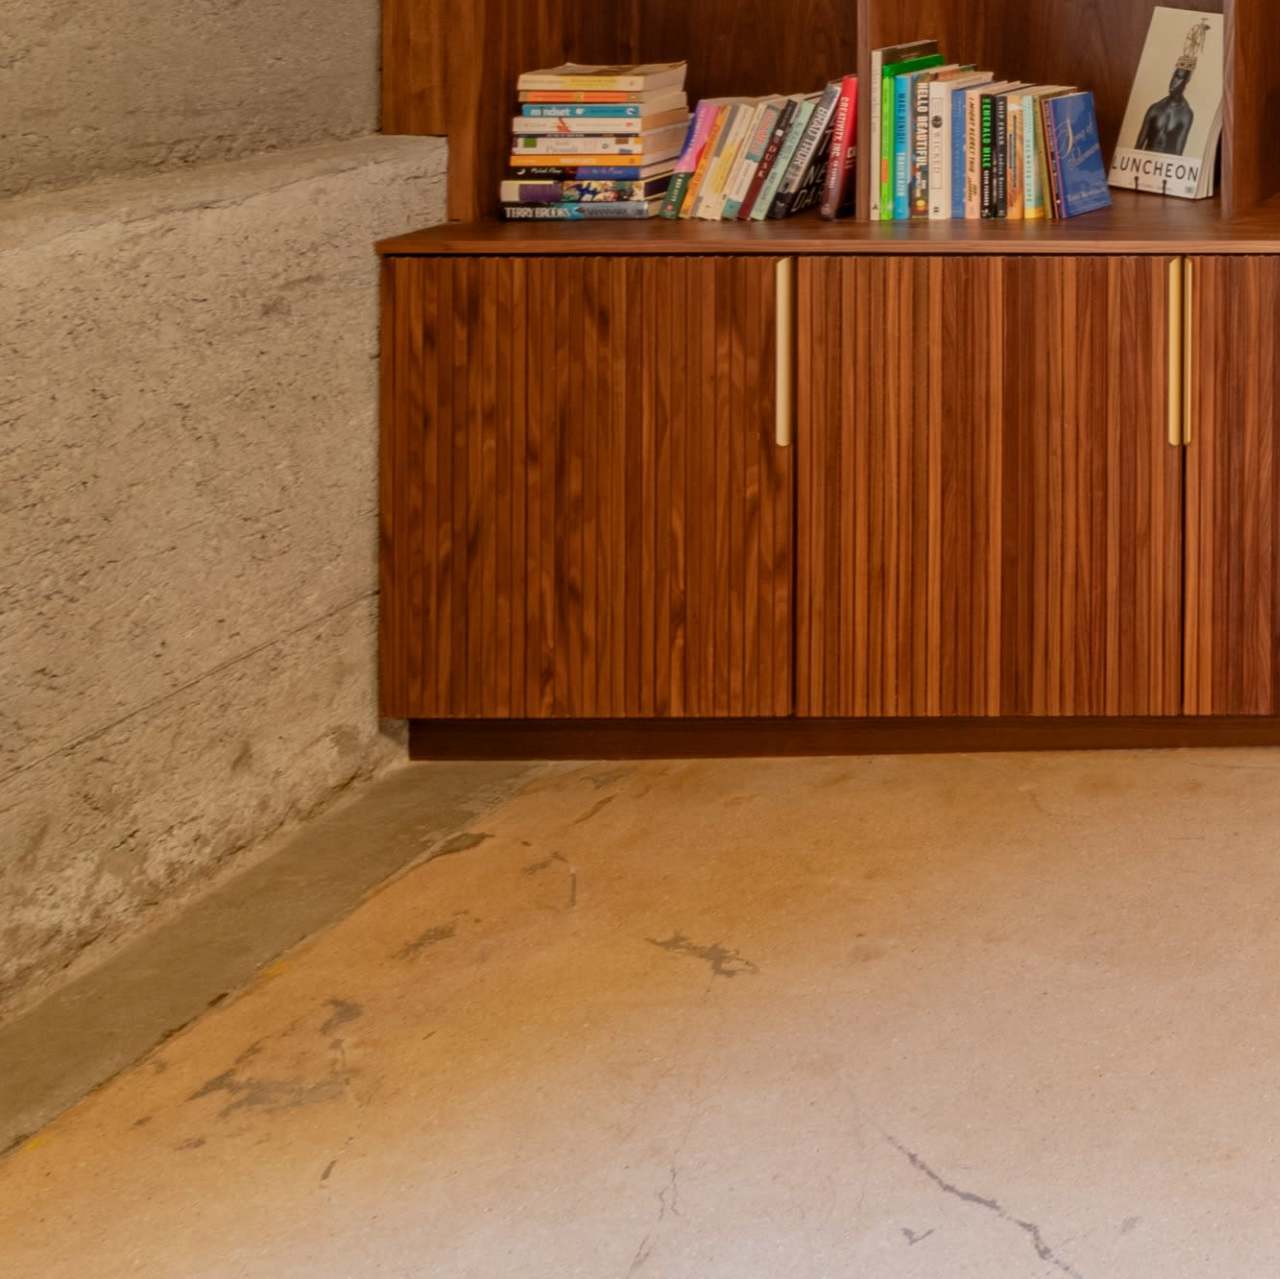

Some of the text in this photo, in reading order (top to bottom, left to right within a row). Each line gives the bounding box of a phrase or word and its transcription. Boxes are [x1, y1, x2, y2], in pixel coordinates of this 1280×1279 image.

[807, 106, 829, 138] BRAD
[916, 82, 928, 169] HELLO BEAUTIFUL
[982, 105, 992, 169] EMERALD MILE
[1112, 156, 1199, 182] LUNCHEON
[505, 207, 569, 218] TERRY BROOKS
